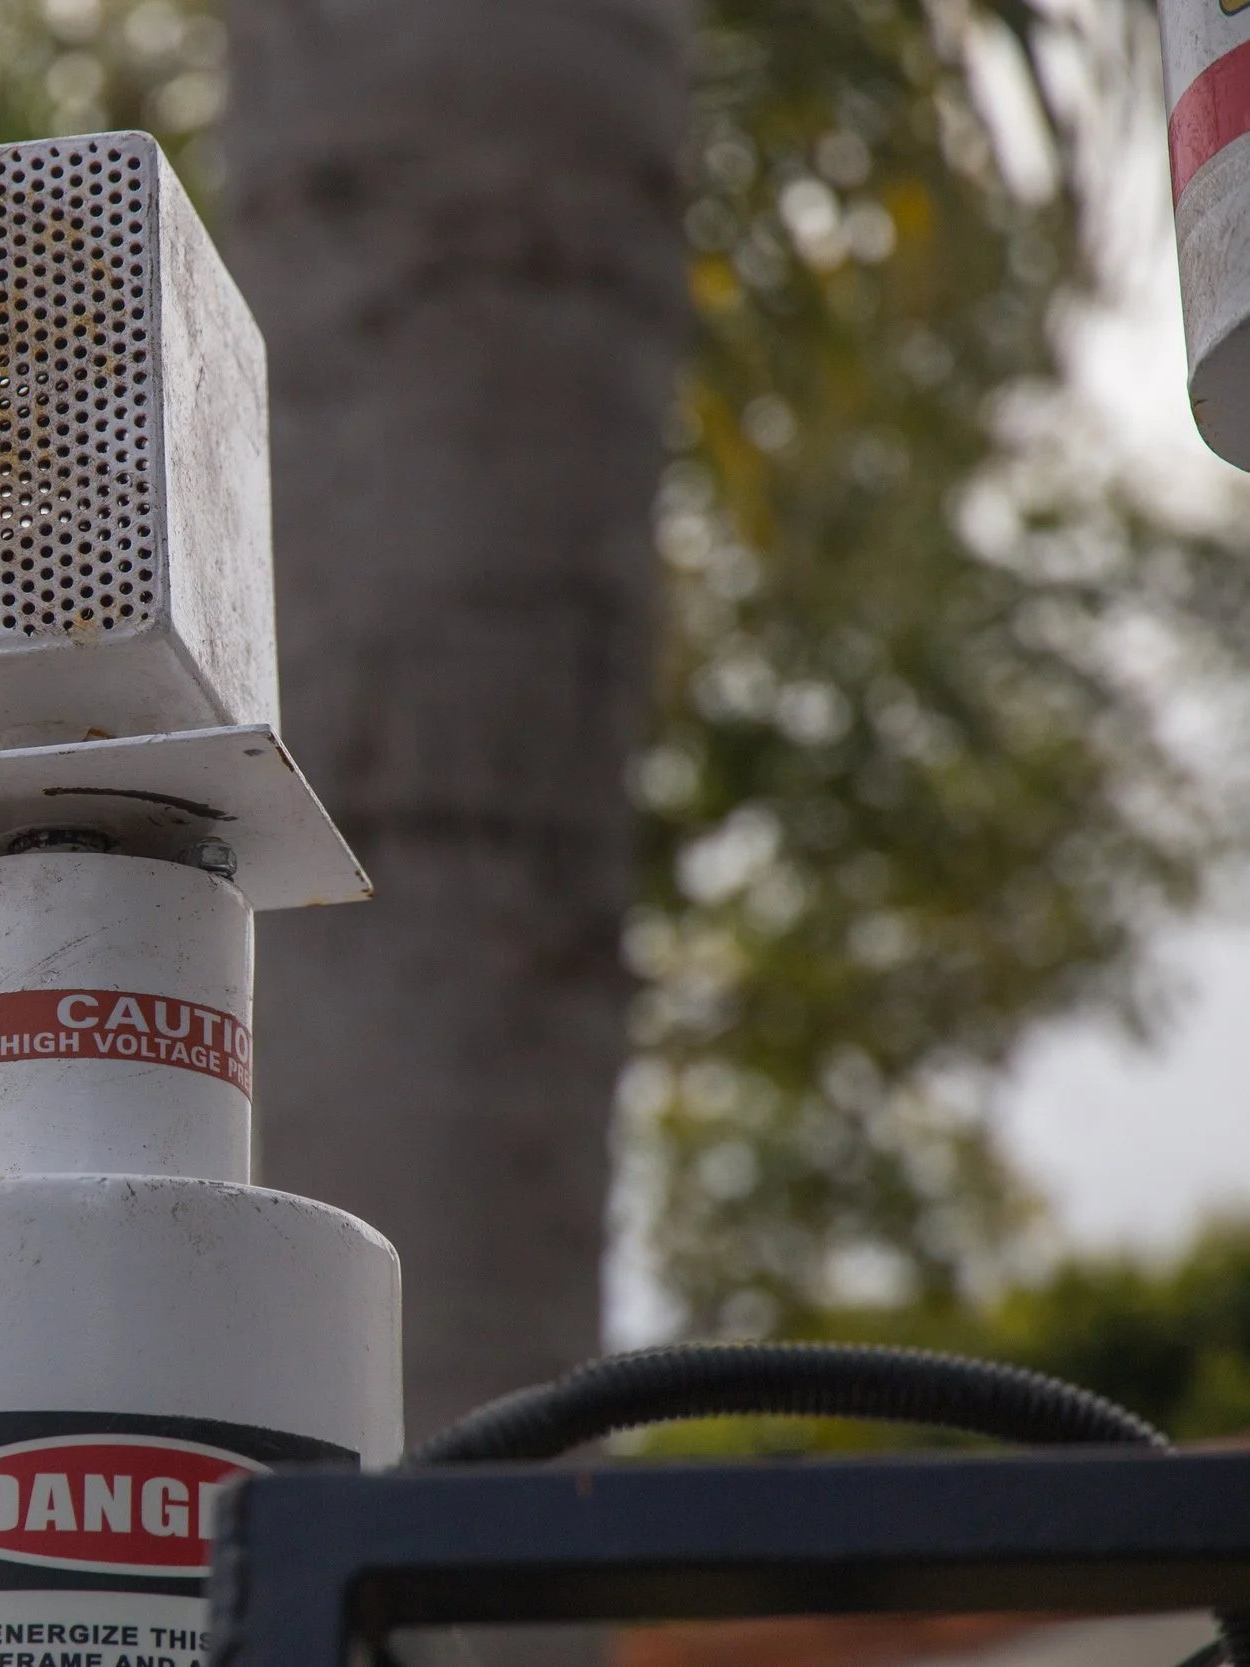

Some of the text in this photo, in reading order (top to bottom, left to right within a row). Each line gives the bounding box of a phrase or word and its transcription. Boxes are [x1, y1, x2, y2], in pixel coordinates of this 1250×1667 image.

[0, 1031, 80, 1056] HIGH
[93, 1032, 221, 1073] VOLTAGE
[150, 1627, 212, 1652] THIS
